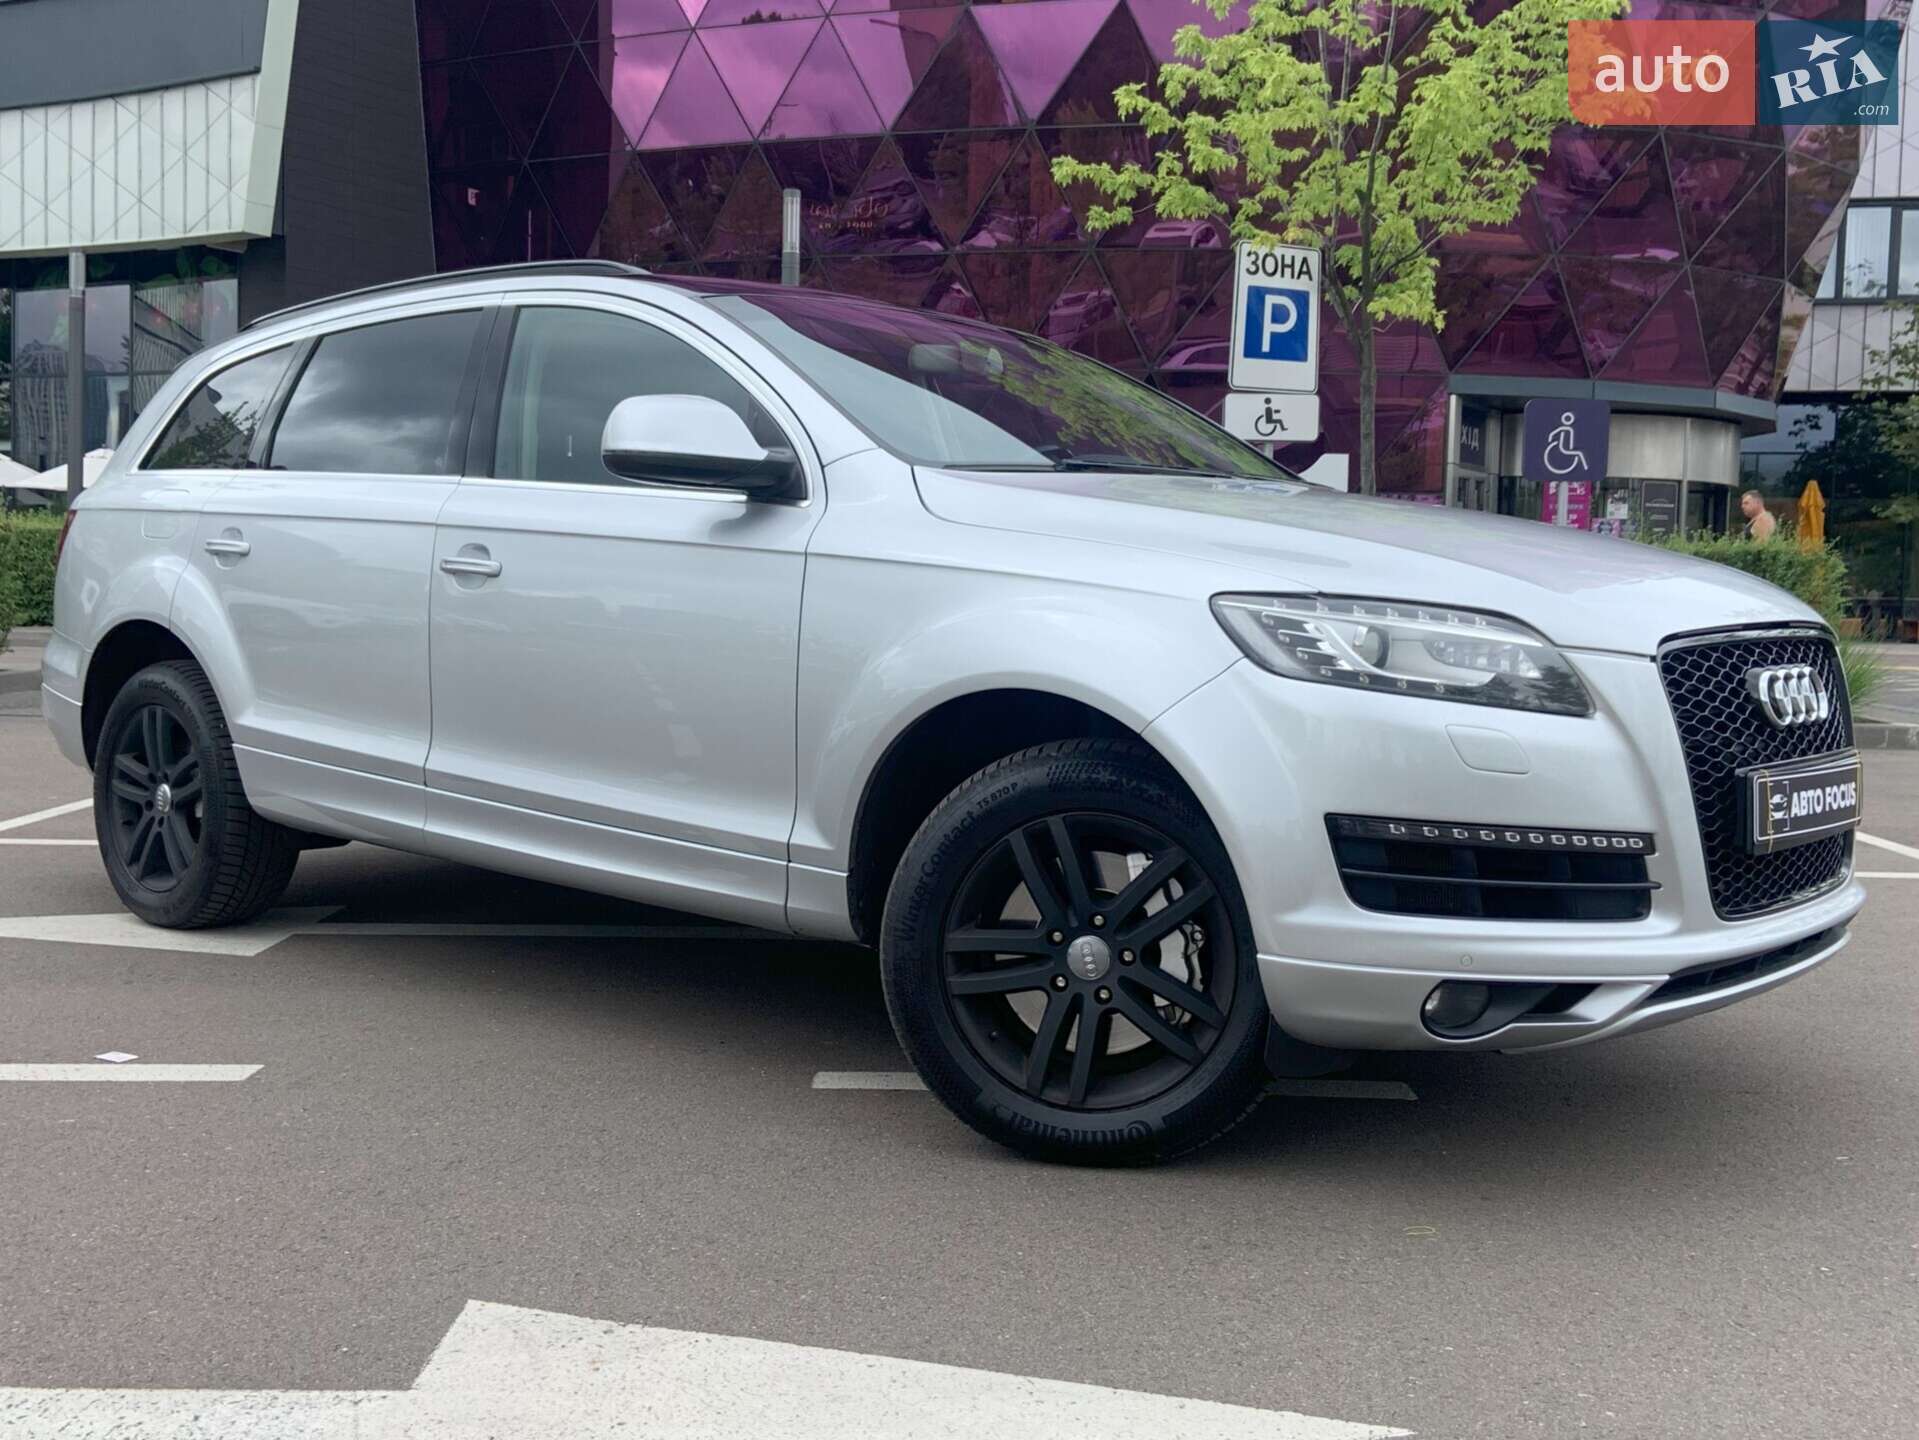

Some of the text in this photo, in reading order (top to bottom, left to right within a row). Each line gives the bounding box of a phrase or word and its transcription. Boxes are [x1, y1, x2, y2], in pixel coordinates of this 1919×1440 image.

[1245, 250, 1313, 282] ЗОНА
[1261, 293, 1298, 353] P
[1460, 424, 1480, 452] ХІД
[1790, 780, 1857, 818] АВТО FOCUS
